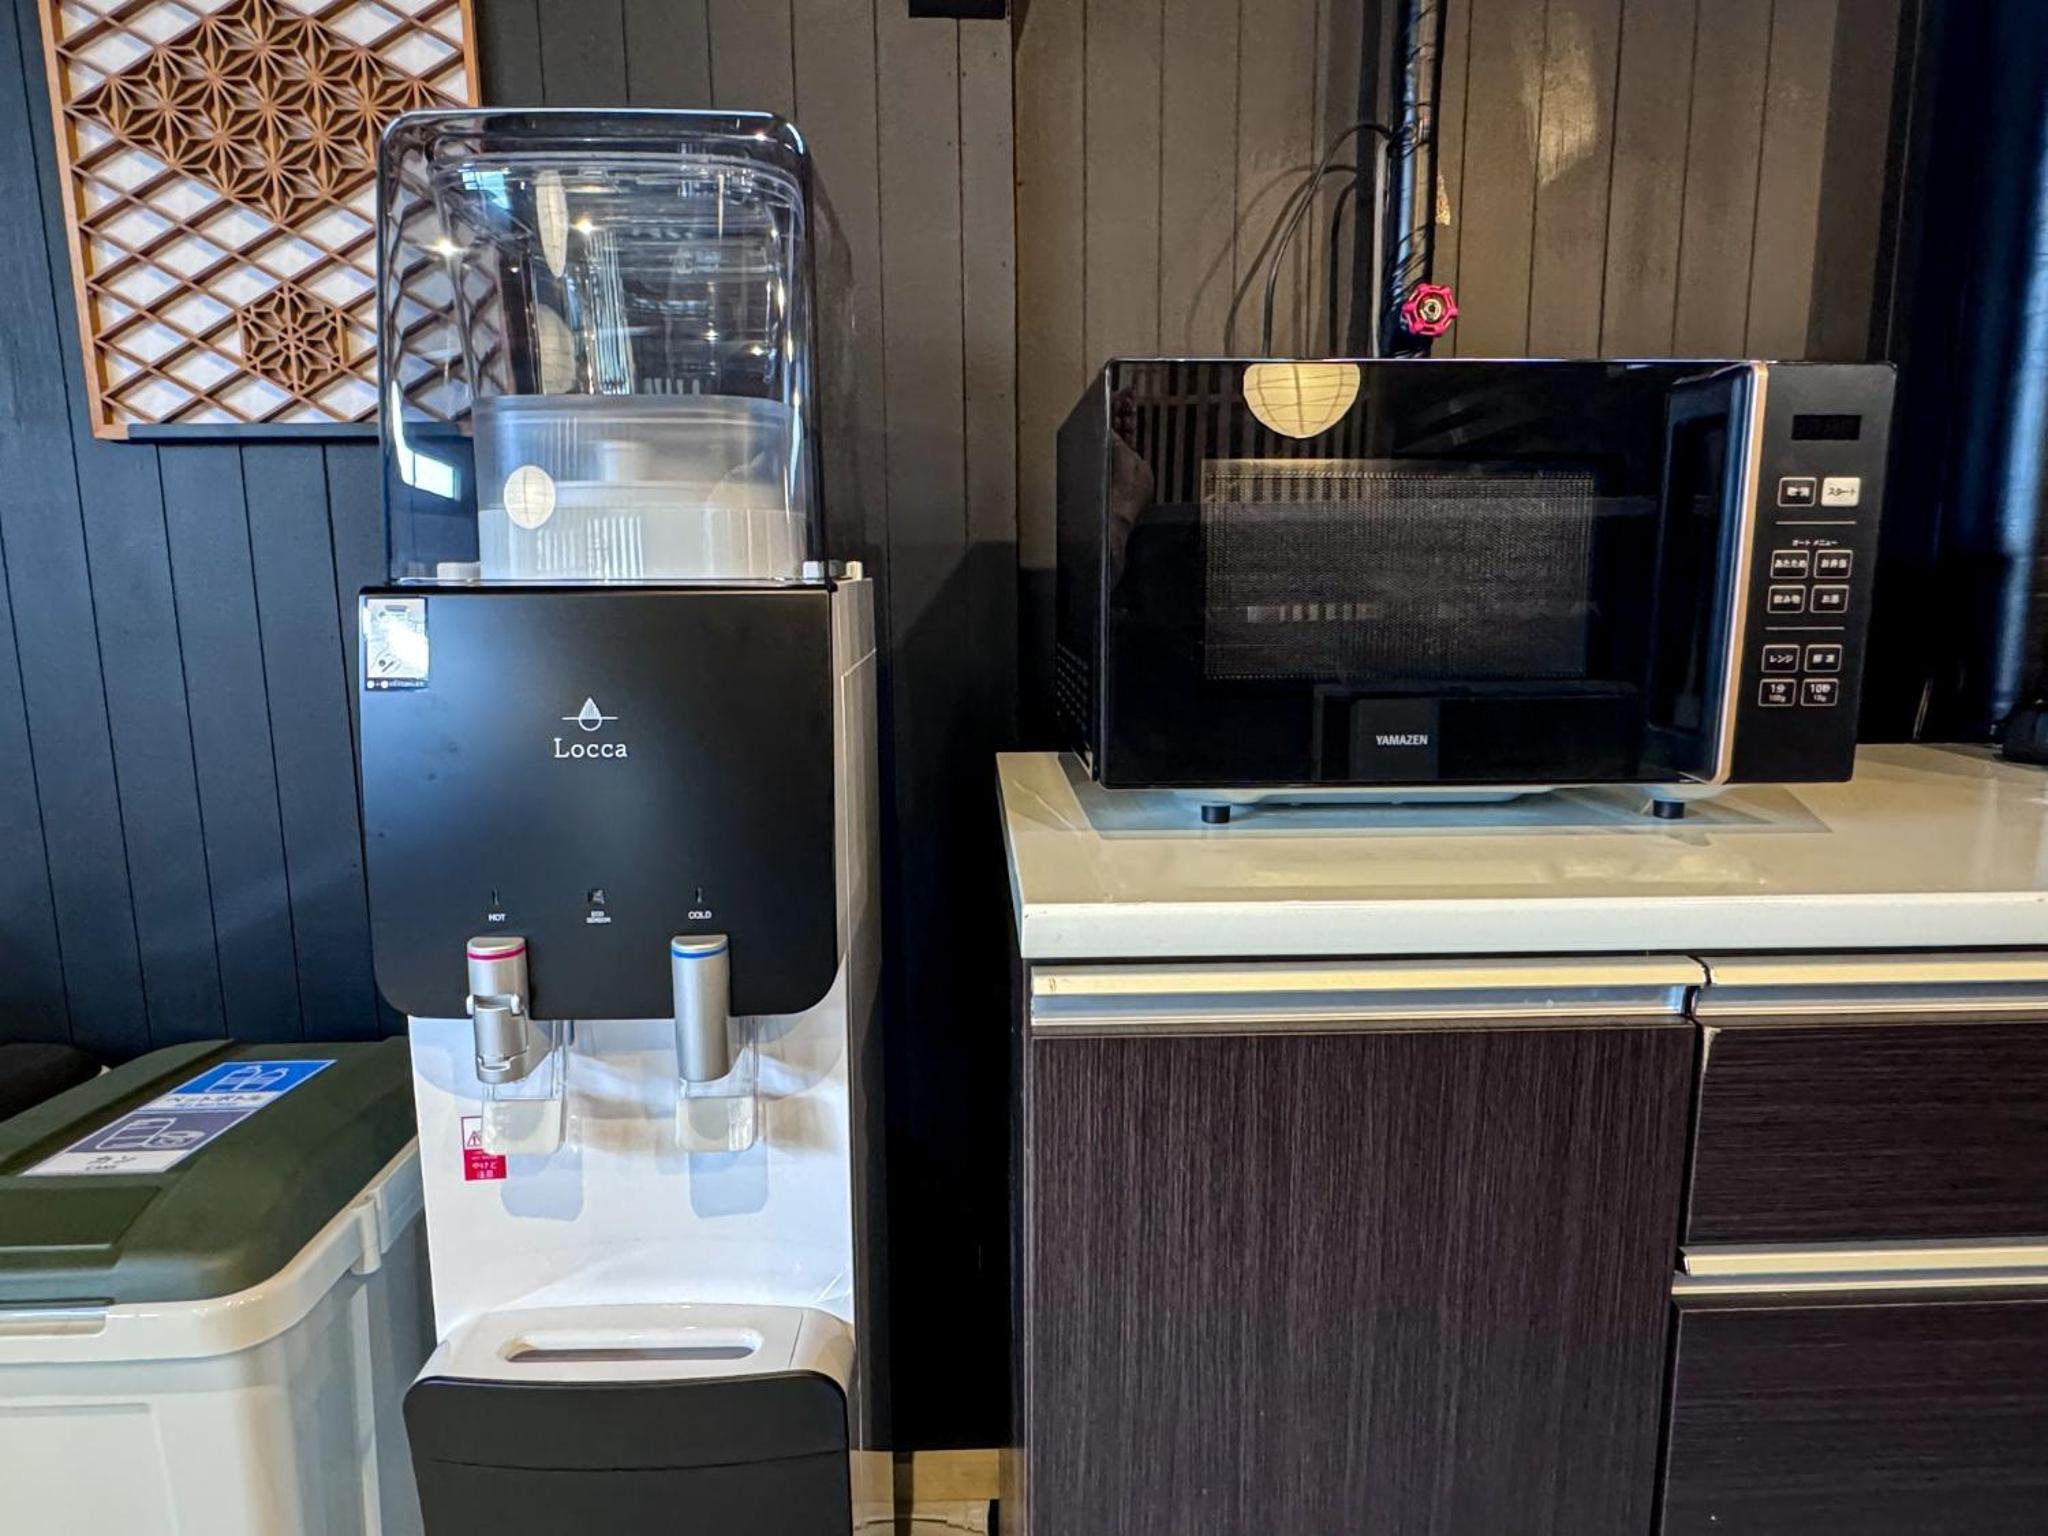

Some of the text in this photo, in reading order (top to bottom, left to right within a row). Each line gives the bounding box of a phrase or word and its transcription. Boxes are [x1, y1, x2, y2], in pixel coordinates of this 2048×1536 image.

[1827, 486, 1857, 497] スタート
[1769, 654, 1794, 664] レンジ
[1375, 734, 1429, 746] YAMAZEN
[553, 737, 628, 759] Locca
[488, 912, 507, 922] HOT
[687, 910, 713, 920] COLD
